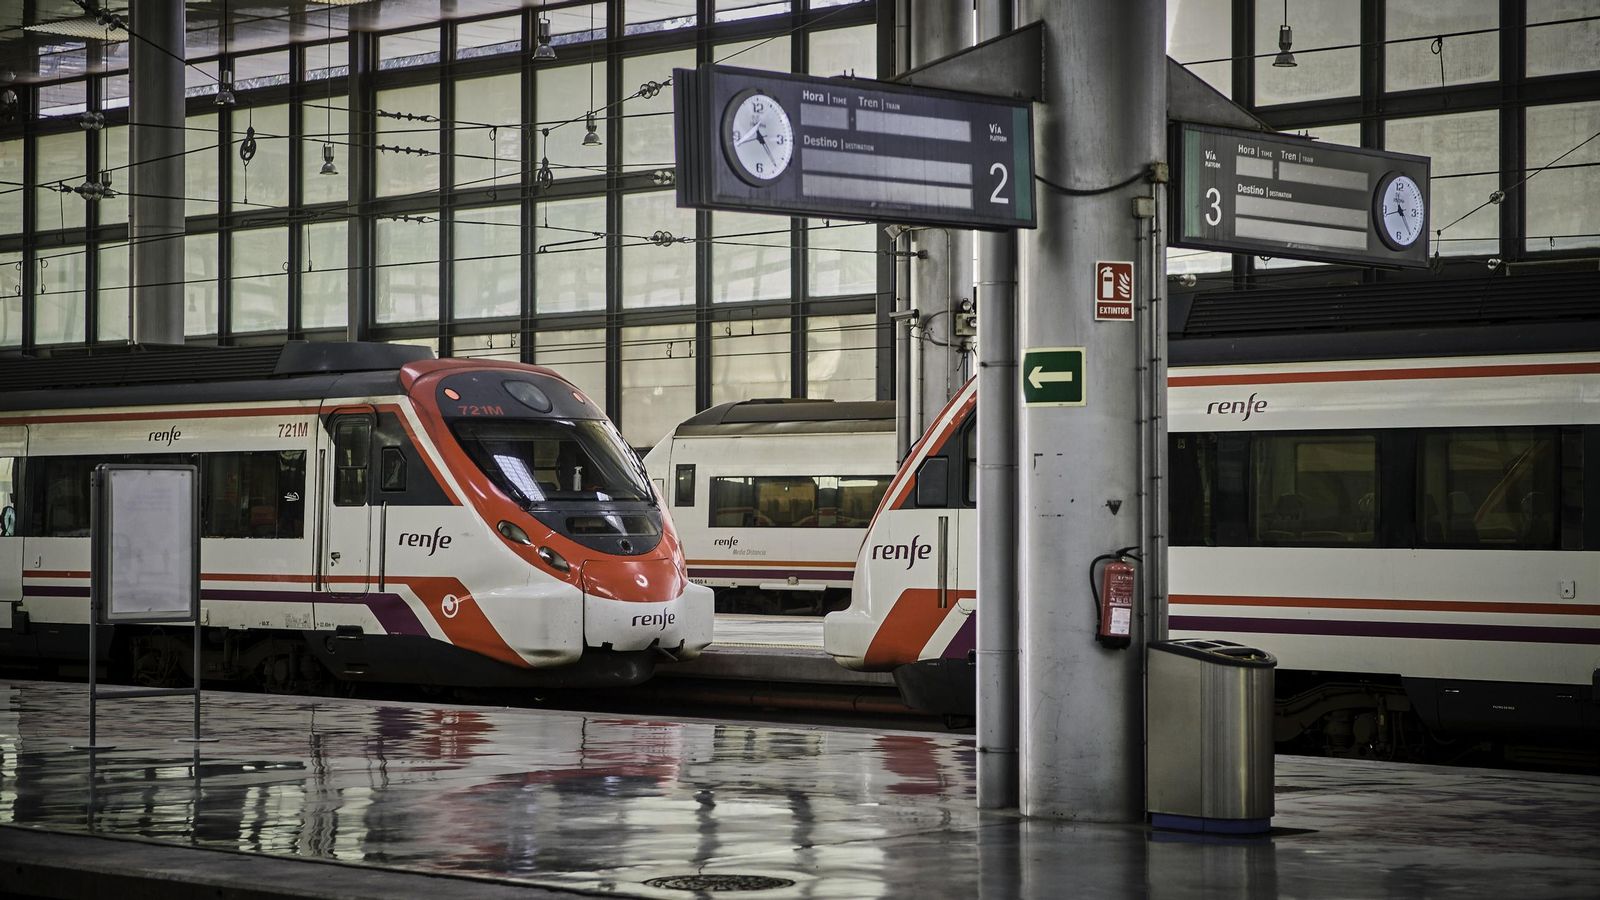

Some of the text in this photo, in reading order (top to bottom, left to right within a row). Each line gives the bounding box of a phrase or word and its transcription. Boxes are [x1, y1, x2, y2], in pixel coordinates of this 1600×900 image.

[802, 89, 847, 105] Hora TIME
[858, 96, 879, 108] Tren
[752, 103, 764, 113] 12
[776, 134, 784, 145] 3
[803, 134, 838, 148] Destino
[1238, 144, 1273, 158] Hora TIME
[1281, 150, 1297, 161] Tren
[756, 162, 763, 173] 6
[989, 162, 1009, 204] 2
[1237, 183, 1264, 196] Destino
[1205, 187, 1222, 226] 3
[1099, 306, 1130, 315] EXTINTOR
[458, 404, 504, 416] 721M
[1206, 392, 1268, 422] renfe
[148, 425, 182, 447] renfe
[278, 422, 309, 438] 721M
[398, 526, 452, 557] renfe
[714, 535, 739, 550] renfe
[871, 534, 932, 571] renfe
[631, 607, 676, 631] renfe
